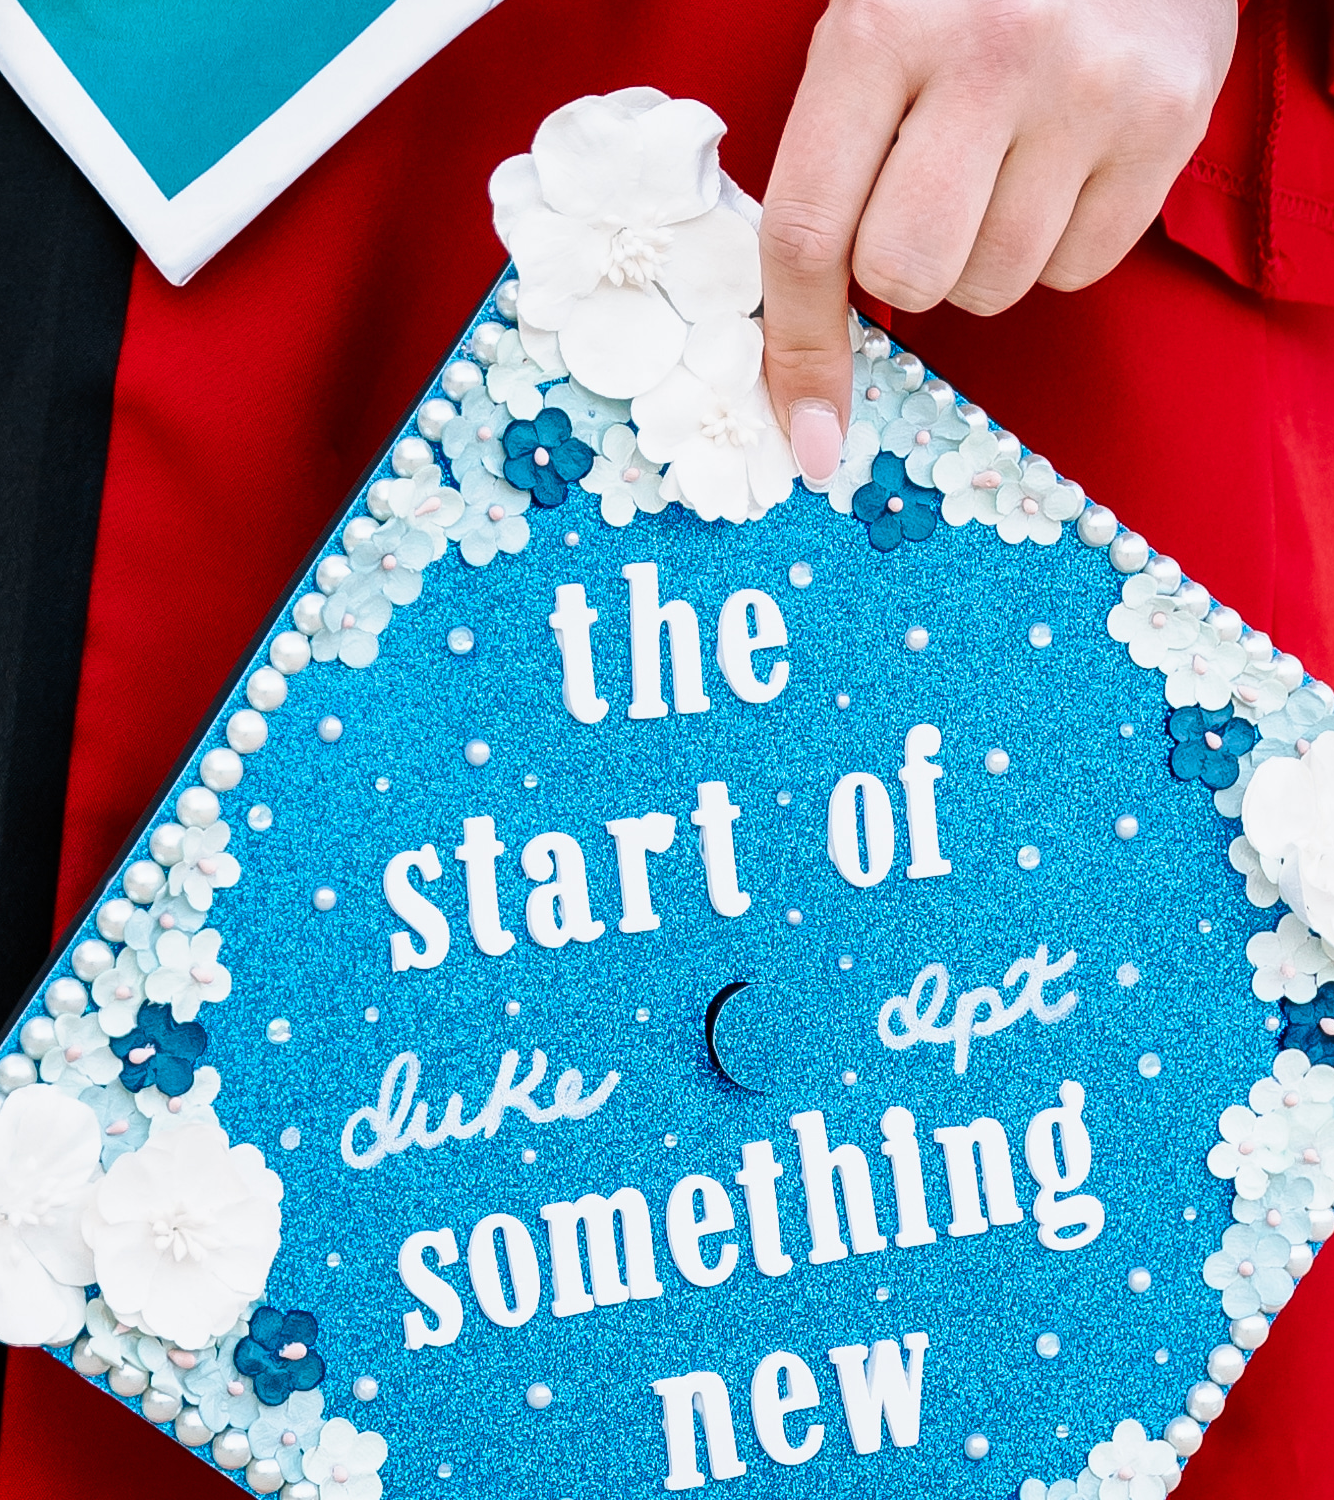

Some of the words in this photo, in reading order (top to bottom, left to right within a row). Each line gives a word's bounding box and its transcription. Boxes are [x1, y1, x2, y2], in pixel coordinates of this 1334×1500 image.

[549, 561, 791, 725] the
[383, 780, 752, 973] start
[827, 722, 953, 888] of
[340, 1047, 621, 1171] duke
[876, 943, 1080, 1075] dpt
[397, 1079, 1107, 1351] something
[649, 1331, 931, 1491] new
